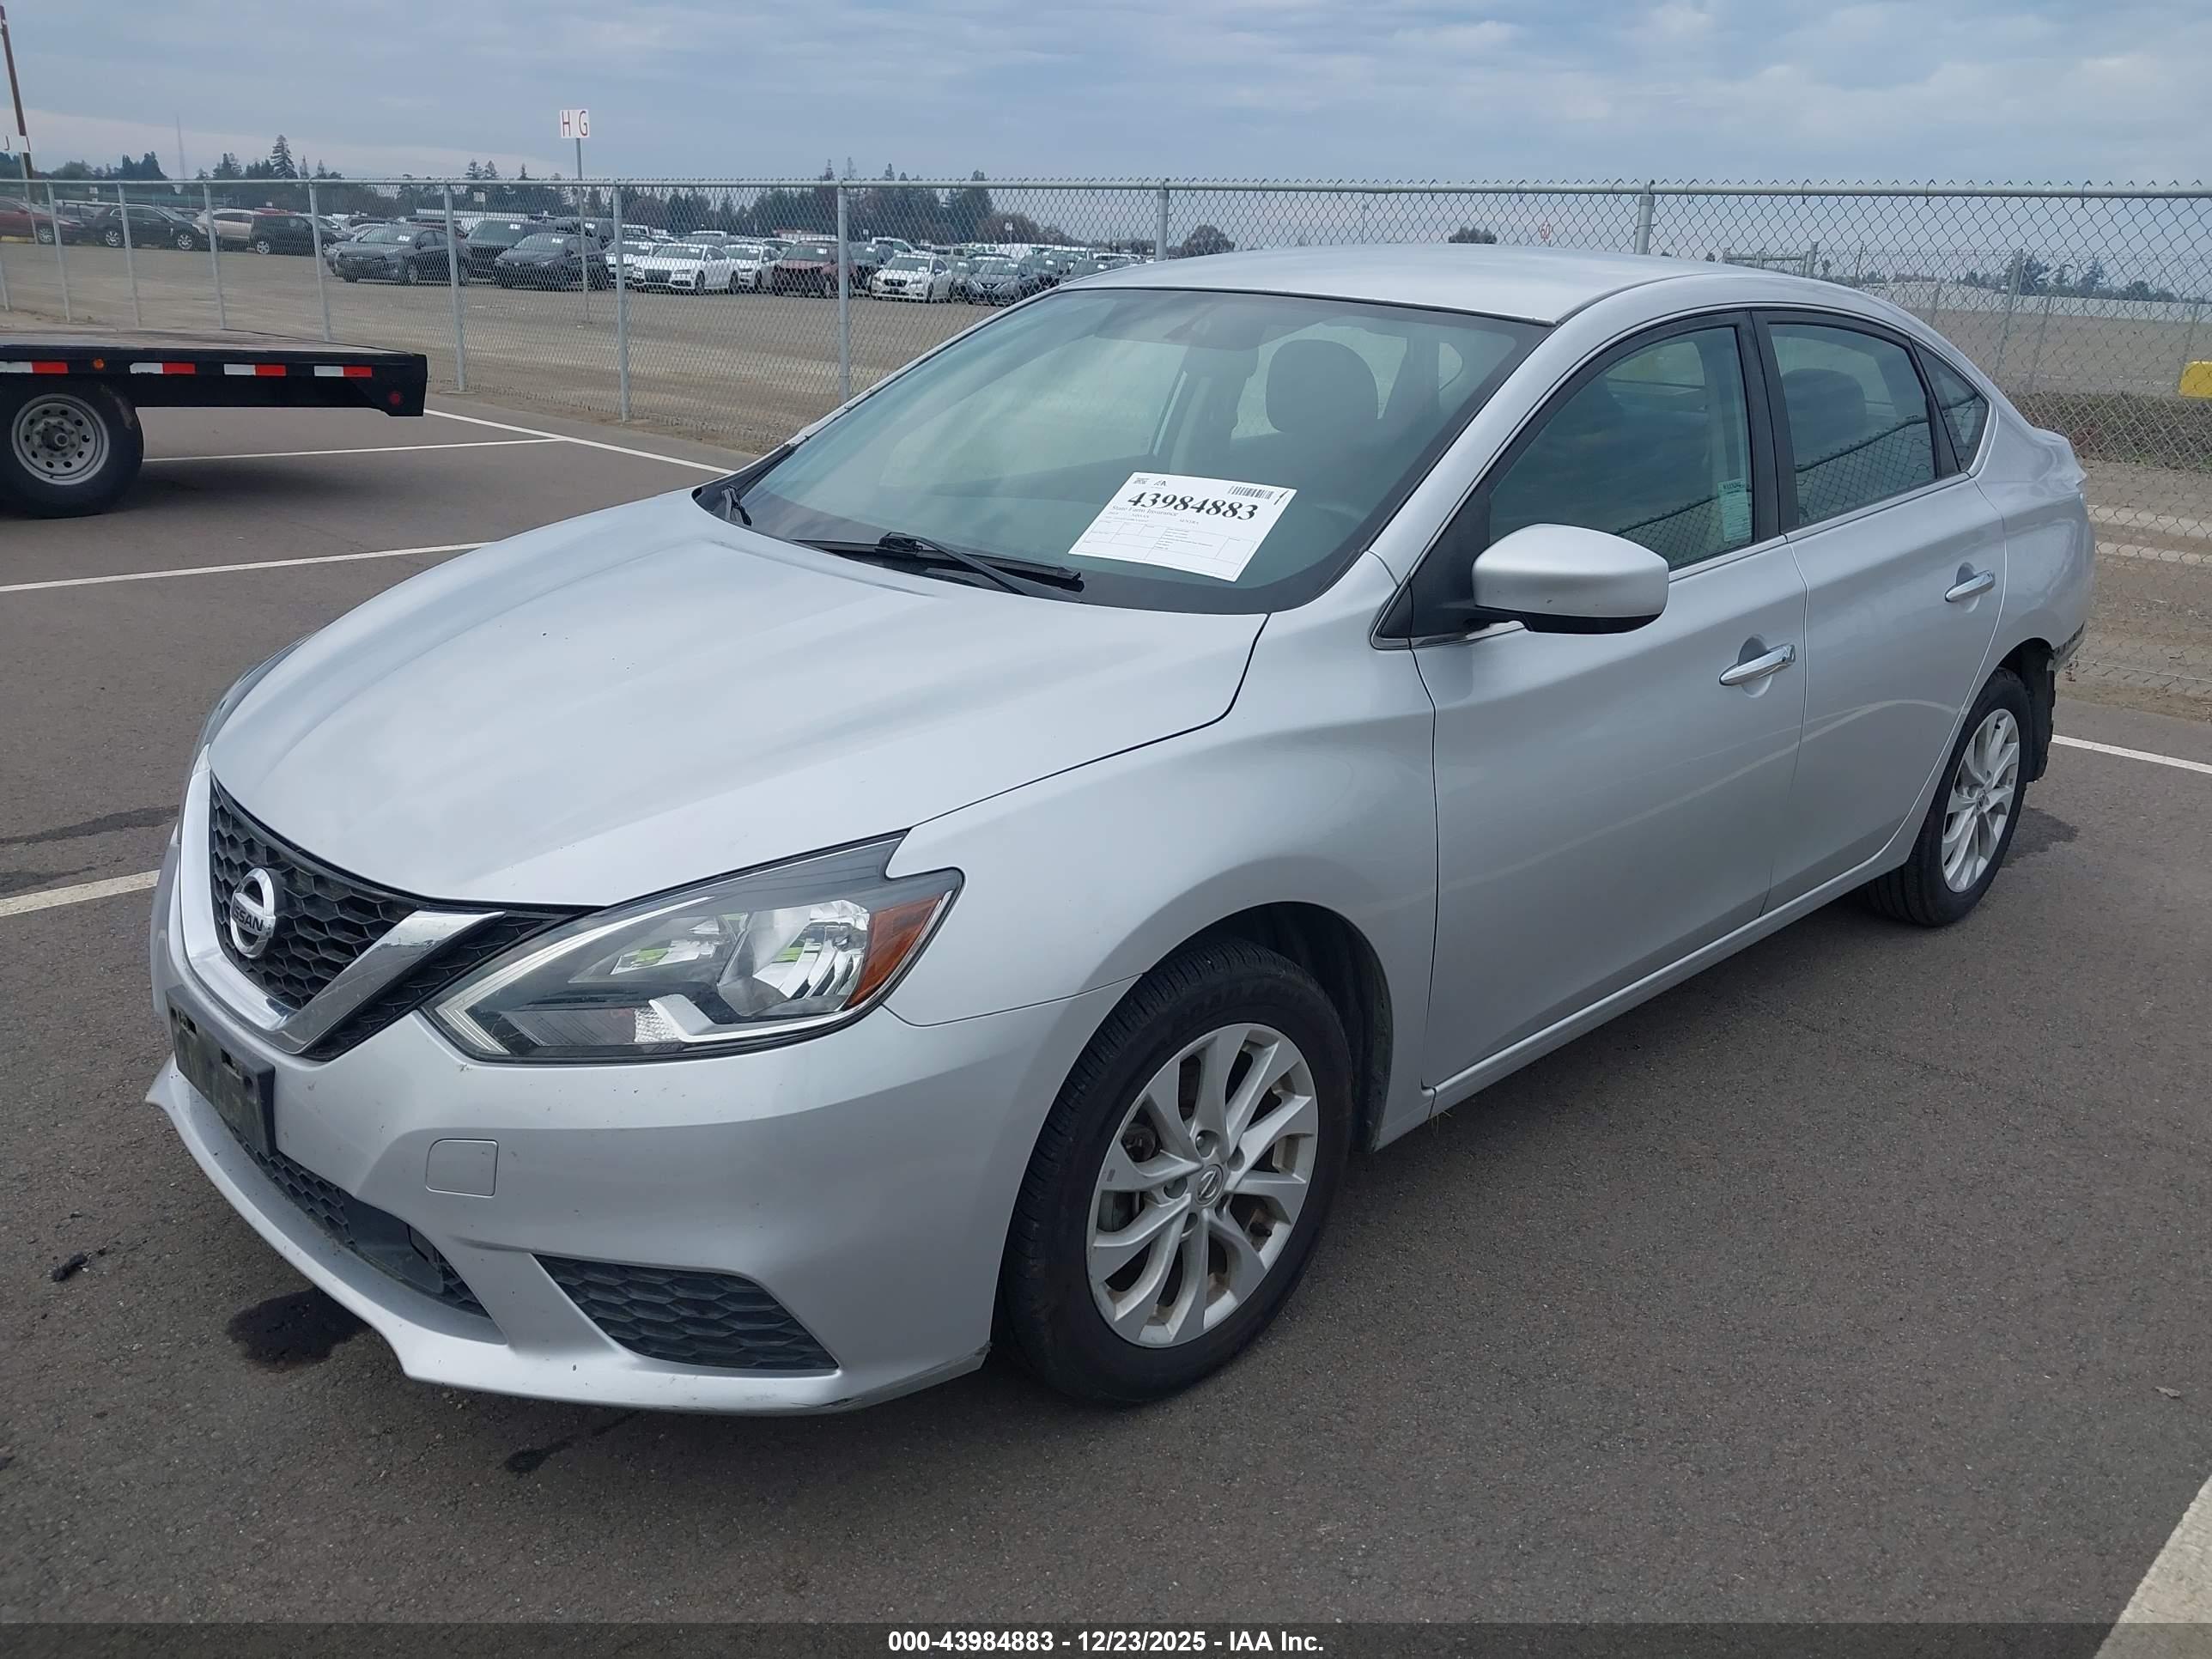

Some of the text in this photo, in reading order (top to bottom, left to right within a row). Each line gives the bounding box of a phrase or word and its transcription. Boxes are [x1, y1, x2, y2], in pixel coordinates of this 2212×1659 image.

[562, 110, 588, 137] H G
[1127, 491, 1258, 520] 43984883
